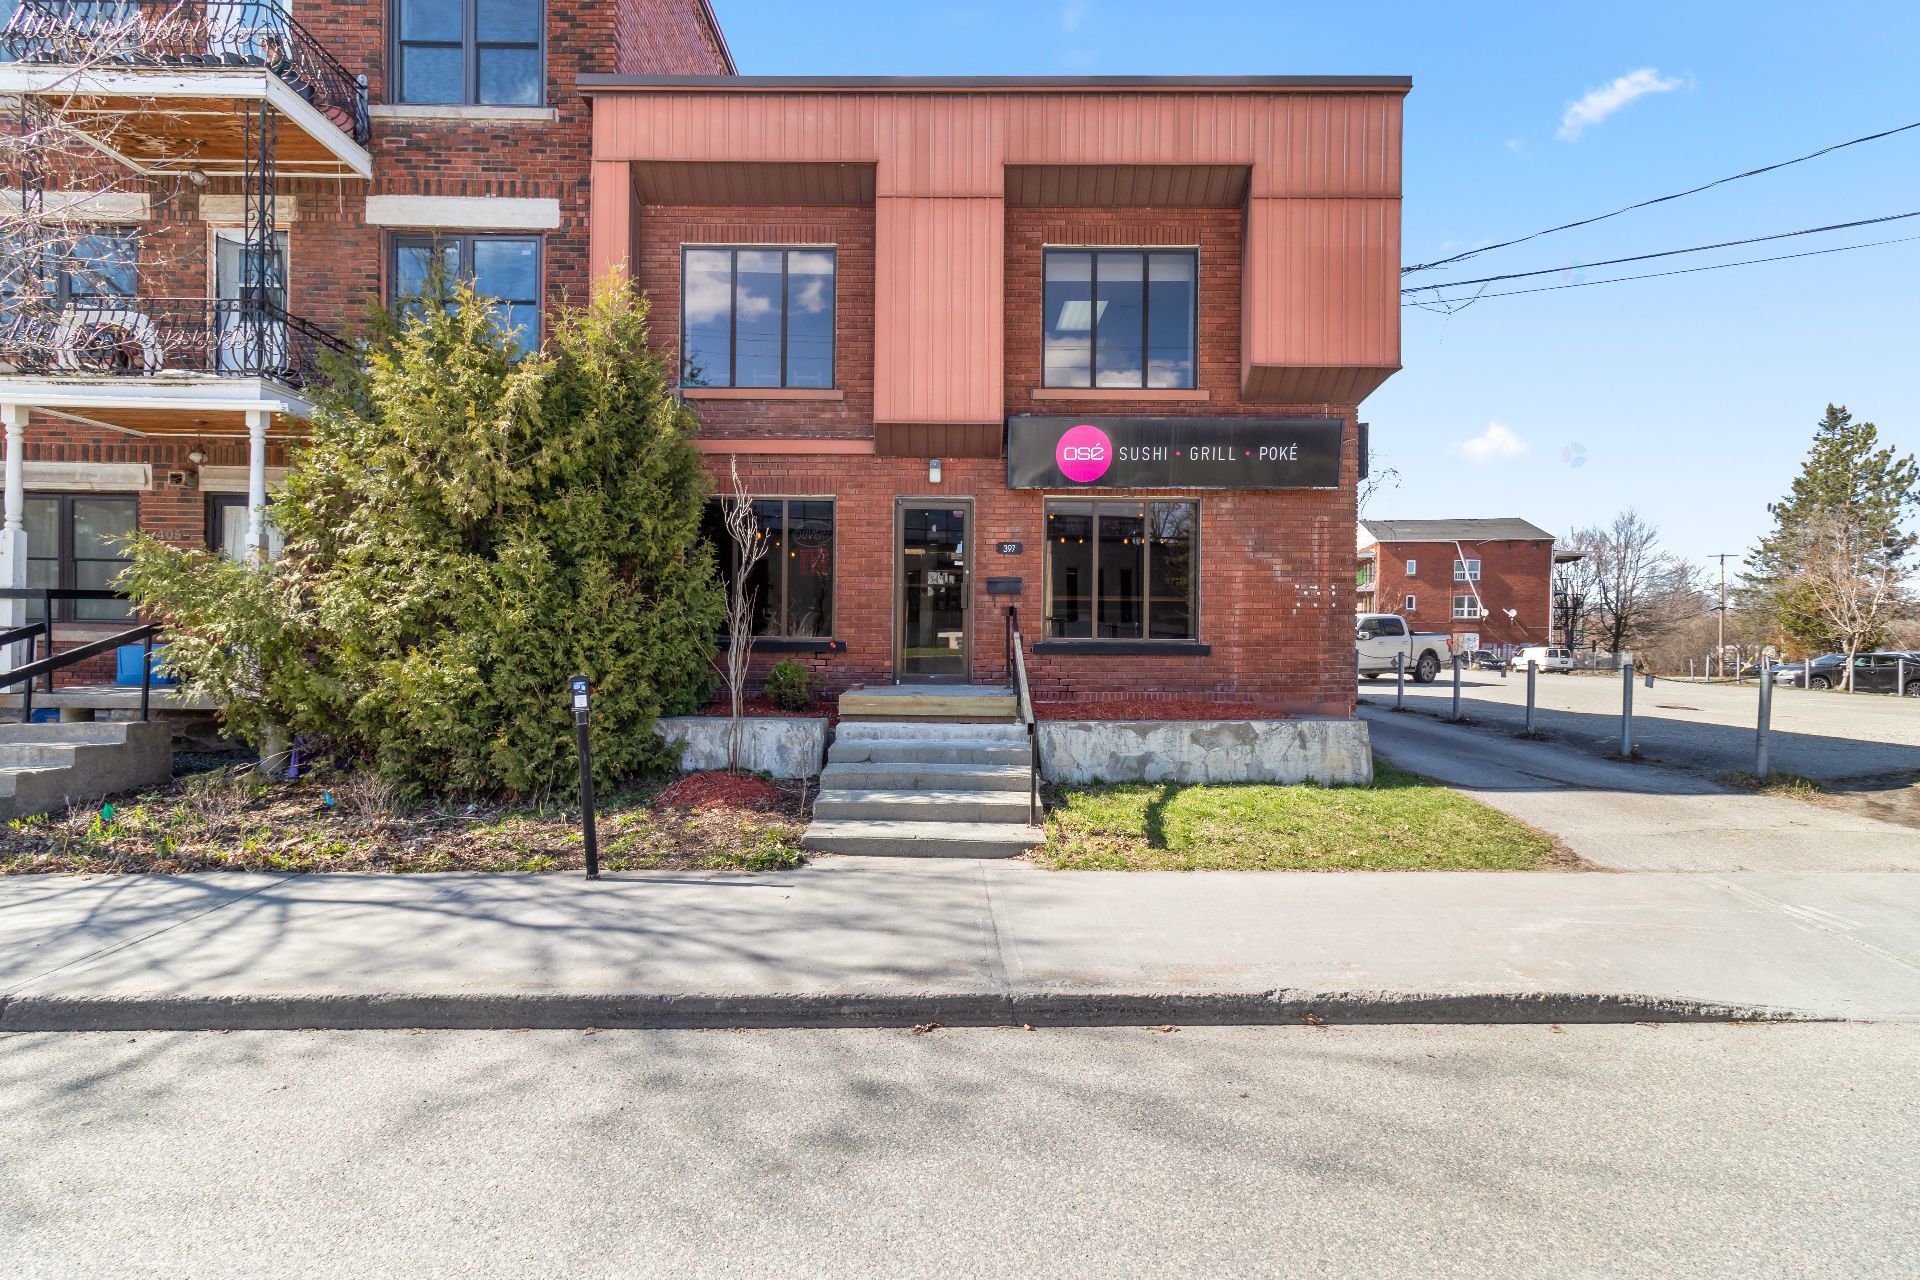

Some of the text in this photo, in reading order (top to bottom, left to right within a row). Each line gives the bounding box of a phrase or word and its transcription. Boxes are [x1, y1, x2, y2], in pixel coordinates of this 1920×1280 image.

[1119, 442, 1298, 461] SUSHI GRILL POKÉ
[156, 529, 182, 540] 405
[1002, 544, 1016, 553] 397
